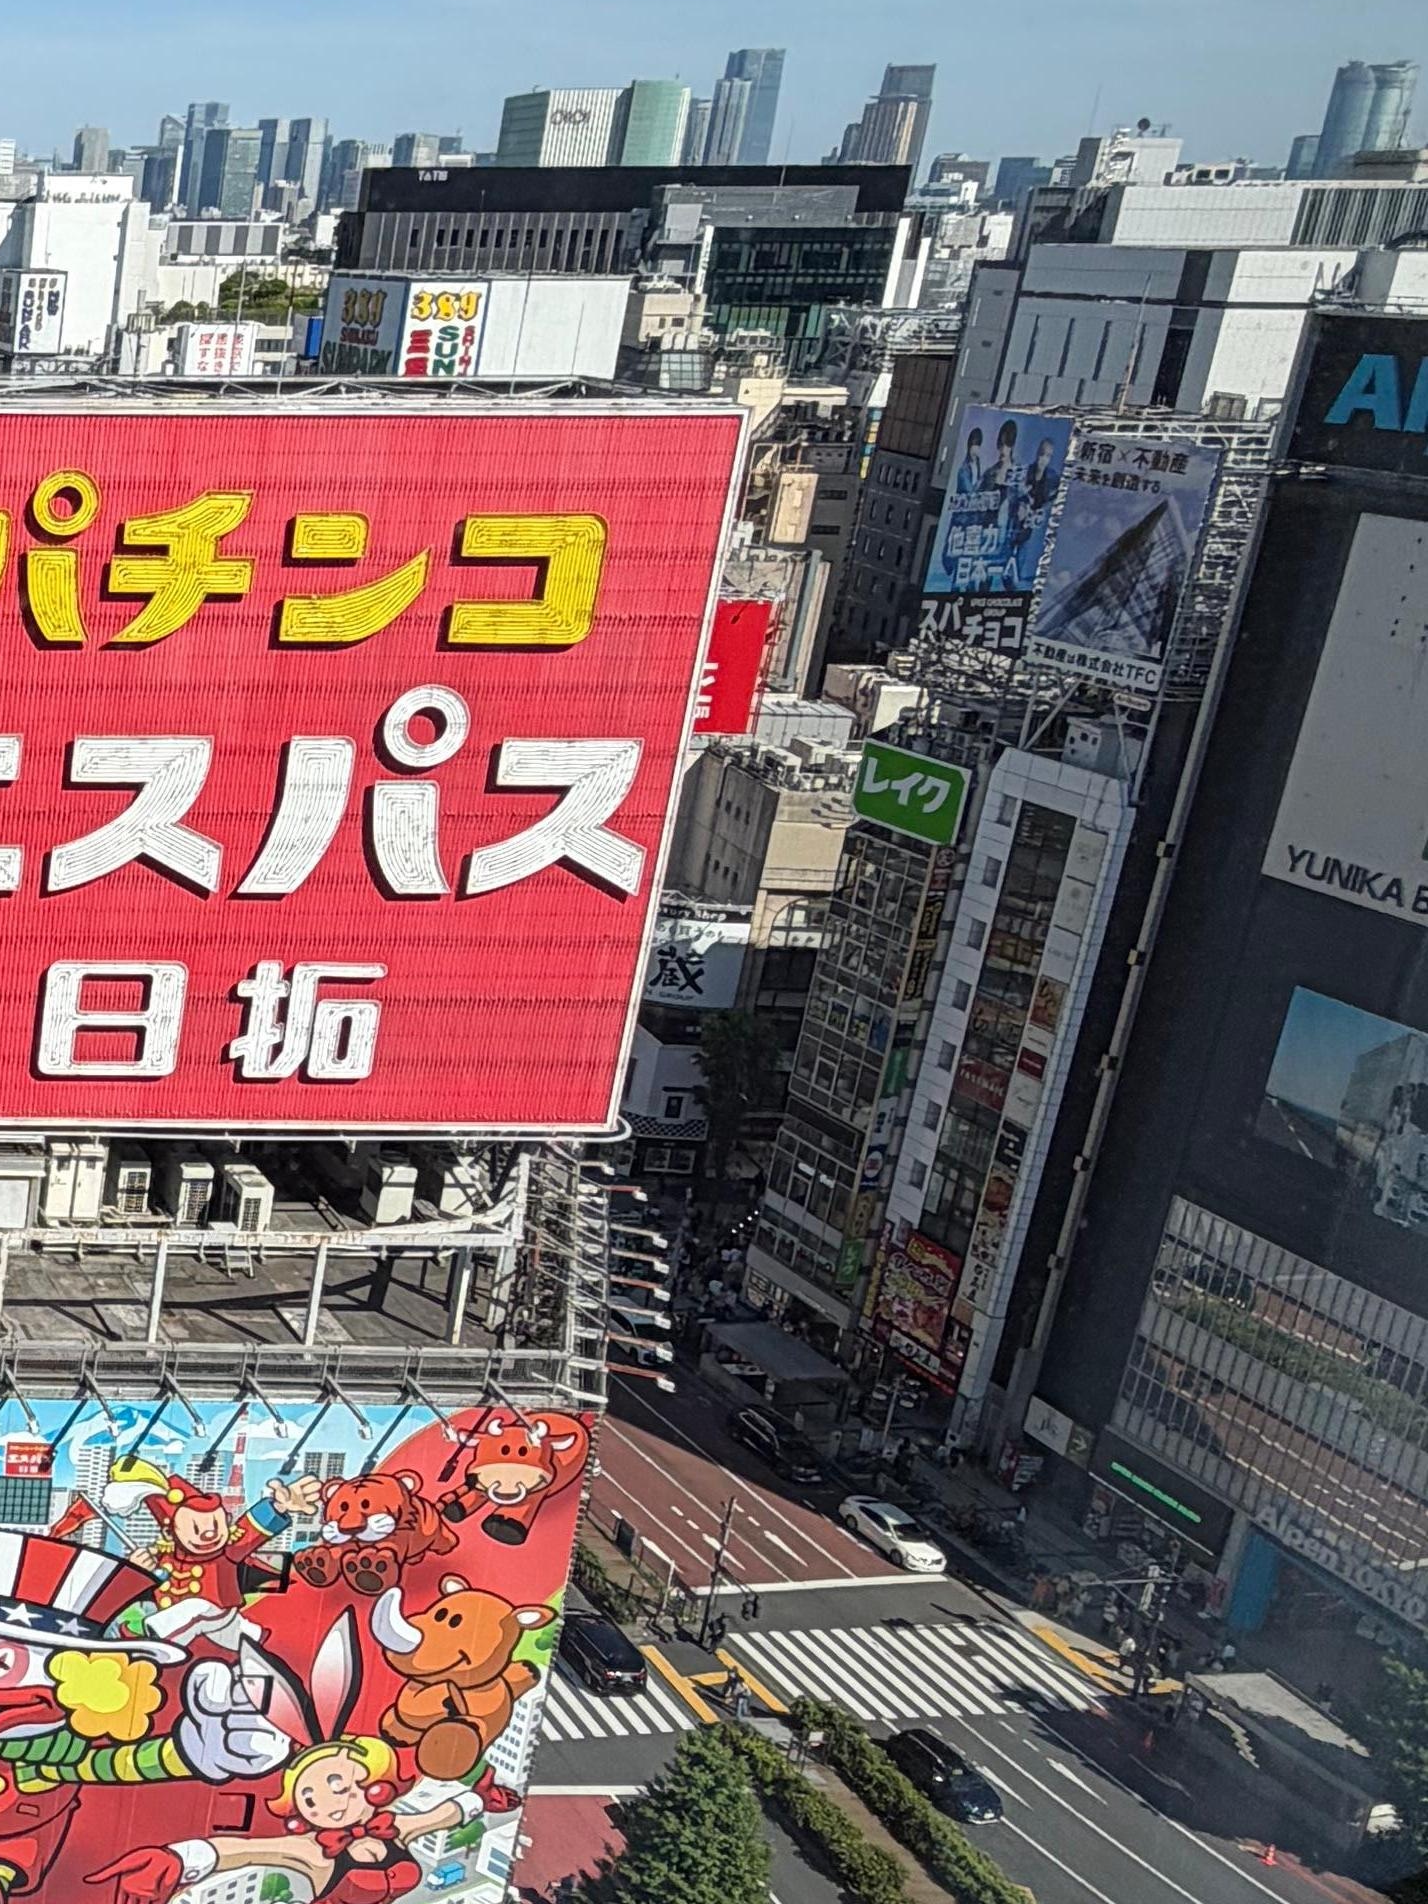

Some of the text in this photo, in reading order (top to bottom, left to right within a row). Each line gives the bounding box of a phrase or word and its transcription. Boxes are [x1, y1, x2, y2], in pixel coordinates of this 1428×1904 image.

[862, 756, 951, 814] レイク
[1287, 844, 1405, 908] YUNIKA
[649, 946, 706, 994] 蔵
[35, 958, 389, 1081] 日拓
